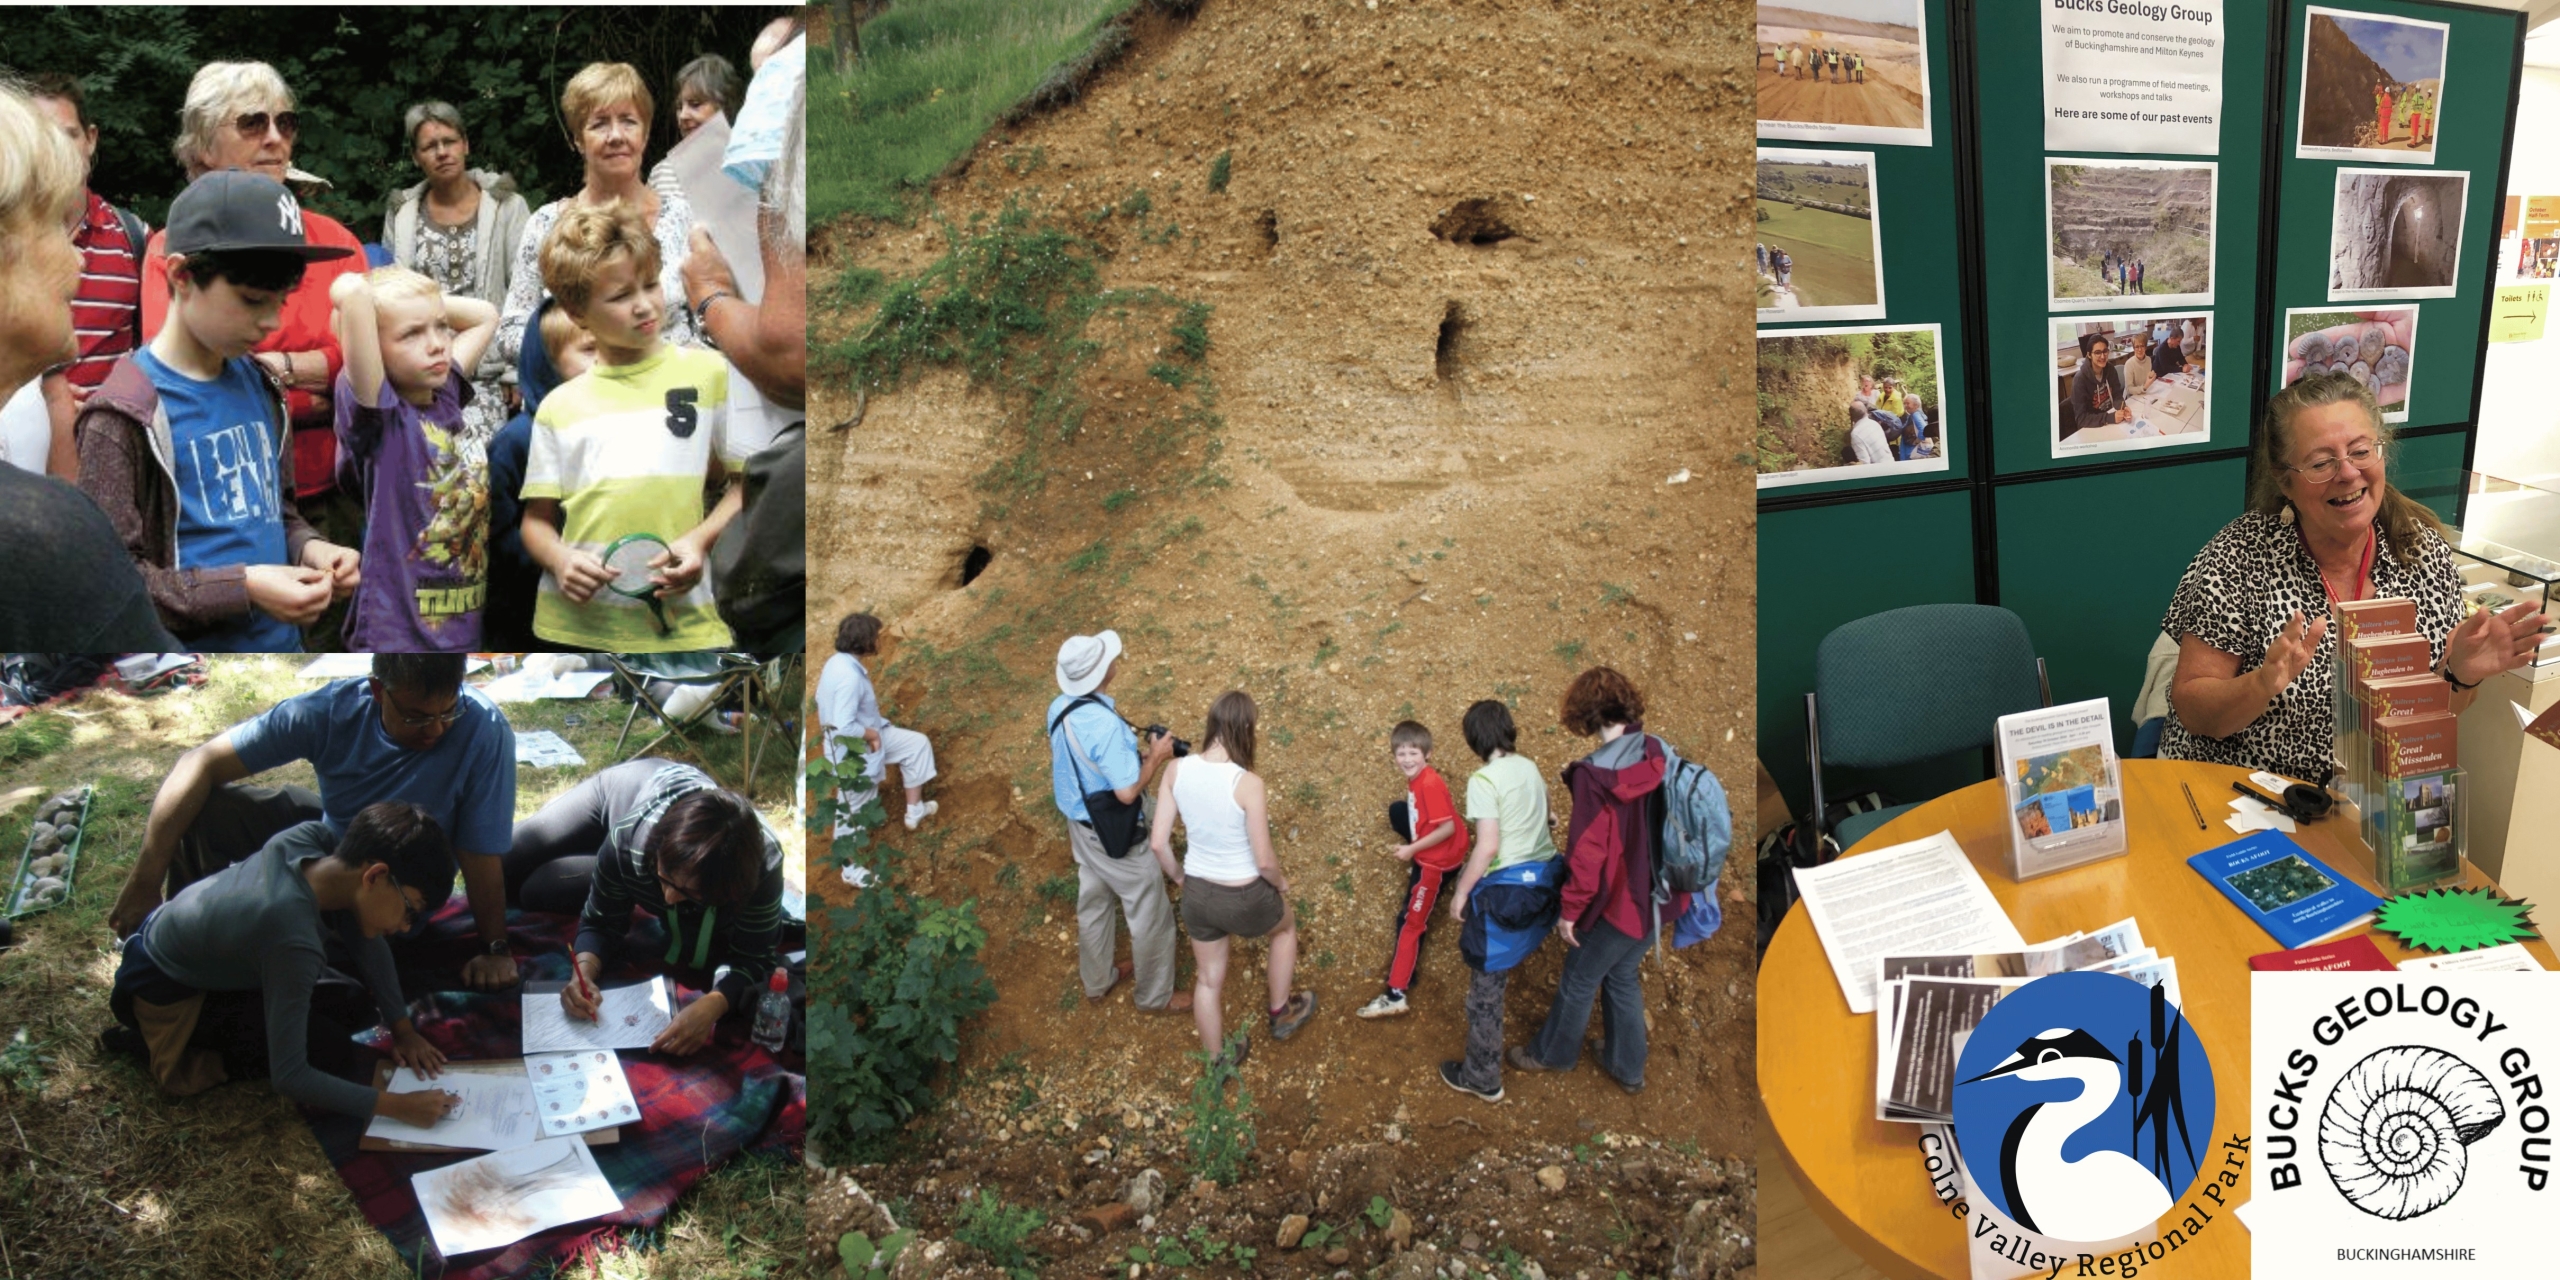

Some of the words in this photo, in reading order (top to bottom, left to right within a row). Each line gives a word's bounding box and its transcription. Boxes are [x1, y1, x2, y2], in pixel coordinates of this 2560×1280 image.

[2107, 0, 2167, 21] Geology
[2171, 4, 2213, 25] Group
[2052, 24, 2065, 34] We
[2067, 26, 2081, 35] aim
[2083, 27, 2091, 36] to
[2092, 28, 2124, 39] promote
[2126, 31, 2139, 40] and
[2141, 33, 2174, 43] conserve
[2176, 35, 2187, 44] the
[2188, 36, 2215, 47] geology
[2065, 40, 2073, 48] of
[2074, 40, 2139, 54] Buckinghamshire
[2140, 46, 2154, 54] and
[2155, 46, 2177, 56] Milton
[2179, 49, 2204, 59] Keynes
[2057, 74, 2070, 83] We
[2071, 75, 2088, 84] also
[2109, 79, 2151, 88] programme
[2152, 79, 2160, 88] of
[2160, 80, 2176, 90] field
[2177, 82, 2211, 92] meetings,
[2100, 90, 2140, 101] workshops
[2141, 92, 2155, 101] and
[2155, 93, 2173, 102] talks
[2054, 107, 2080, 119] Here
[2082, 110, 2098, 120] are
[2100, 111, 2128, 121] some
[2130, 110, 2140, 121] of
[2142, 113, 2158, 122] our
[2160, 113, 2181, 124] past
[2182, 114, 2213, 125] events
[2501, 295, 2522, 303] Toilets
[665, 387, 698, 439] 5
[2357, 620, 2383, 629] Chiltern
[2384, 619, 2400, 627] Trails
[2371, 657, 2396, 665] Chiltern
[2371, 667, 2406, 676] Hughenden
[2390, 698, 2416, 706] Chiltern
[2389, 707, 2414, 716] Great
[2009, 728, 2024, 737] THE
[2026, 724, 2046, 734] DEVIL
[2056, 720, 2064, 728] IN
[2065, 718, 2079, 726] THE
[2080, 714, 2104, 724] DETAIL
[2399, 736, 2424, 744] Chiltern
[2425, 732, 2442, 740] Trails
[2399, 744, 2423, 755] Great
[2399, 752, 2442, 766] Missenden
